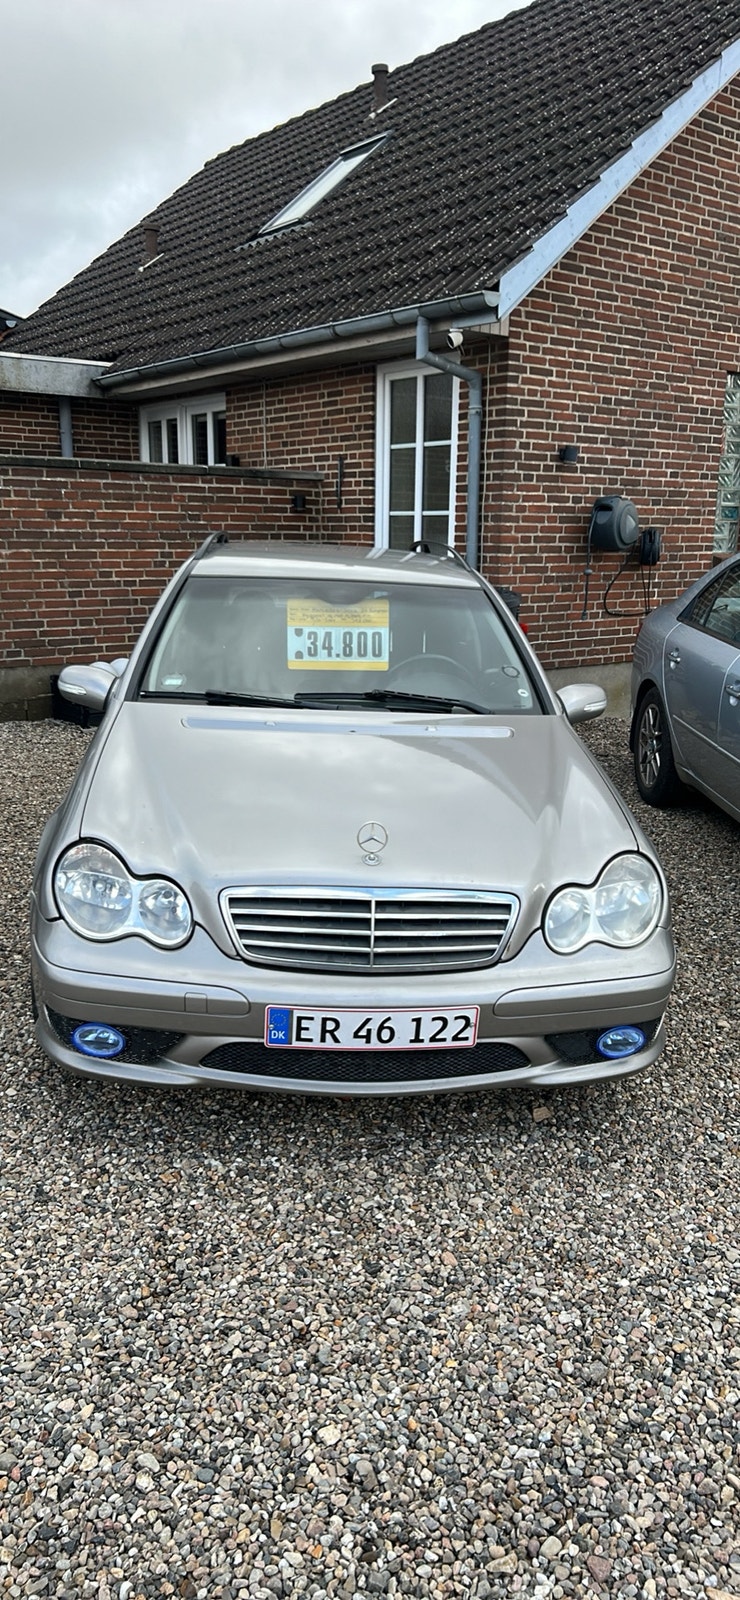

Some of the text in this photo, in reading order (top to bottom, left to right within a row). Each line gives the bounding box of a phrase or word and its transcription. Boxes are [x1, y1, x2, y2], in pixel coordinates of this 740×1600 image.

[307, 631, 383, 658] 34.800
[271, 1030, 285, 1040] DK
[295, 1015, 472, 1044] ER 46 122
